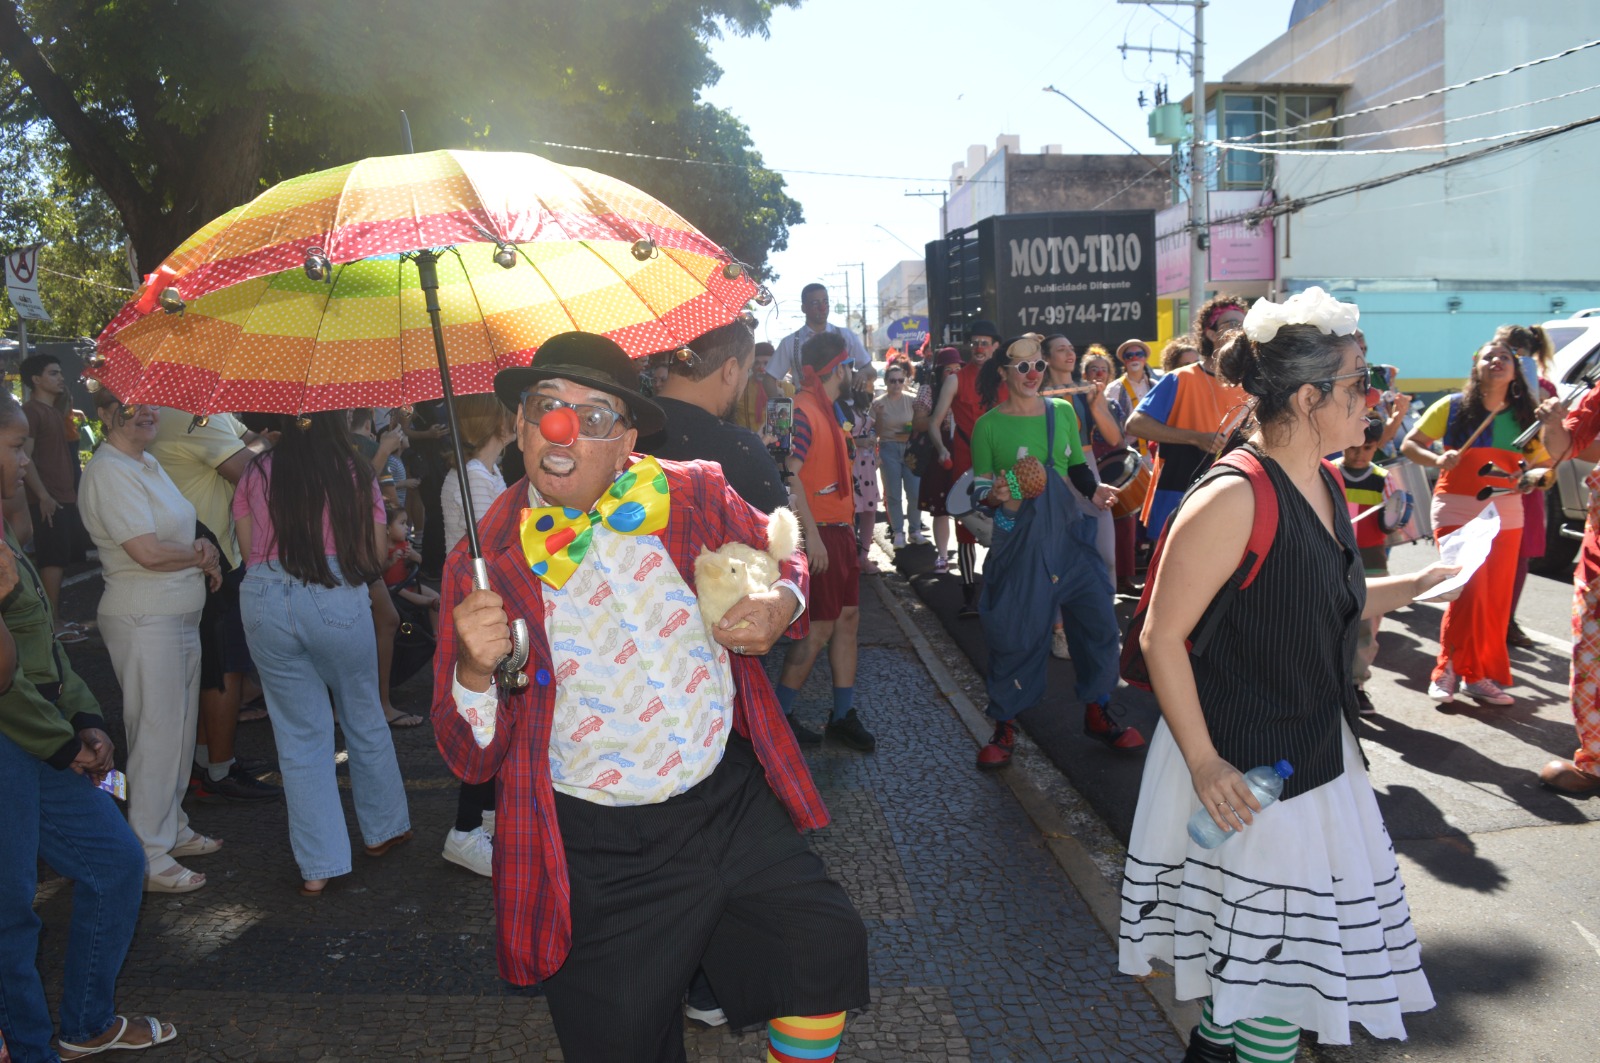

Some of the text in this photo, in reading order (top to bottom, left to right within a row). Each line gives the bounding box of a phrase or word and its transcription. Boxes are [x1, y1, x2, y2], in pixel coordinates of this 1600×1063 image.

[1009, 232, 1142, 278] MOTO-TRIO
[1024, 280, 1131, 294] A Publicidade Diferente
[1018, 301, 1142, 327] 17-99744-7279
